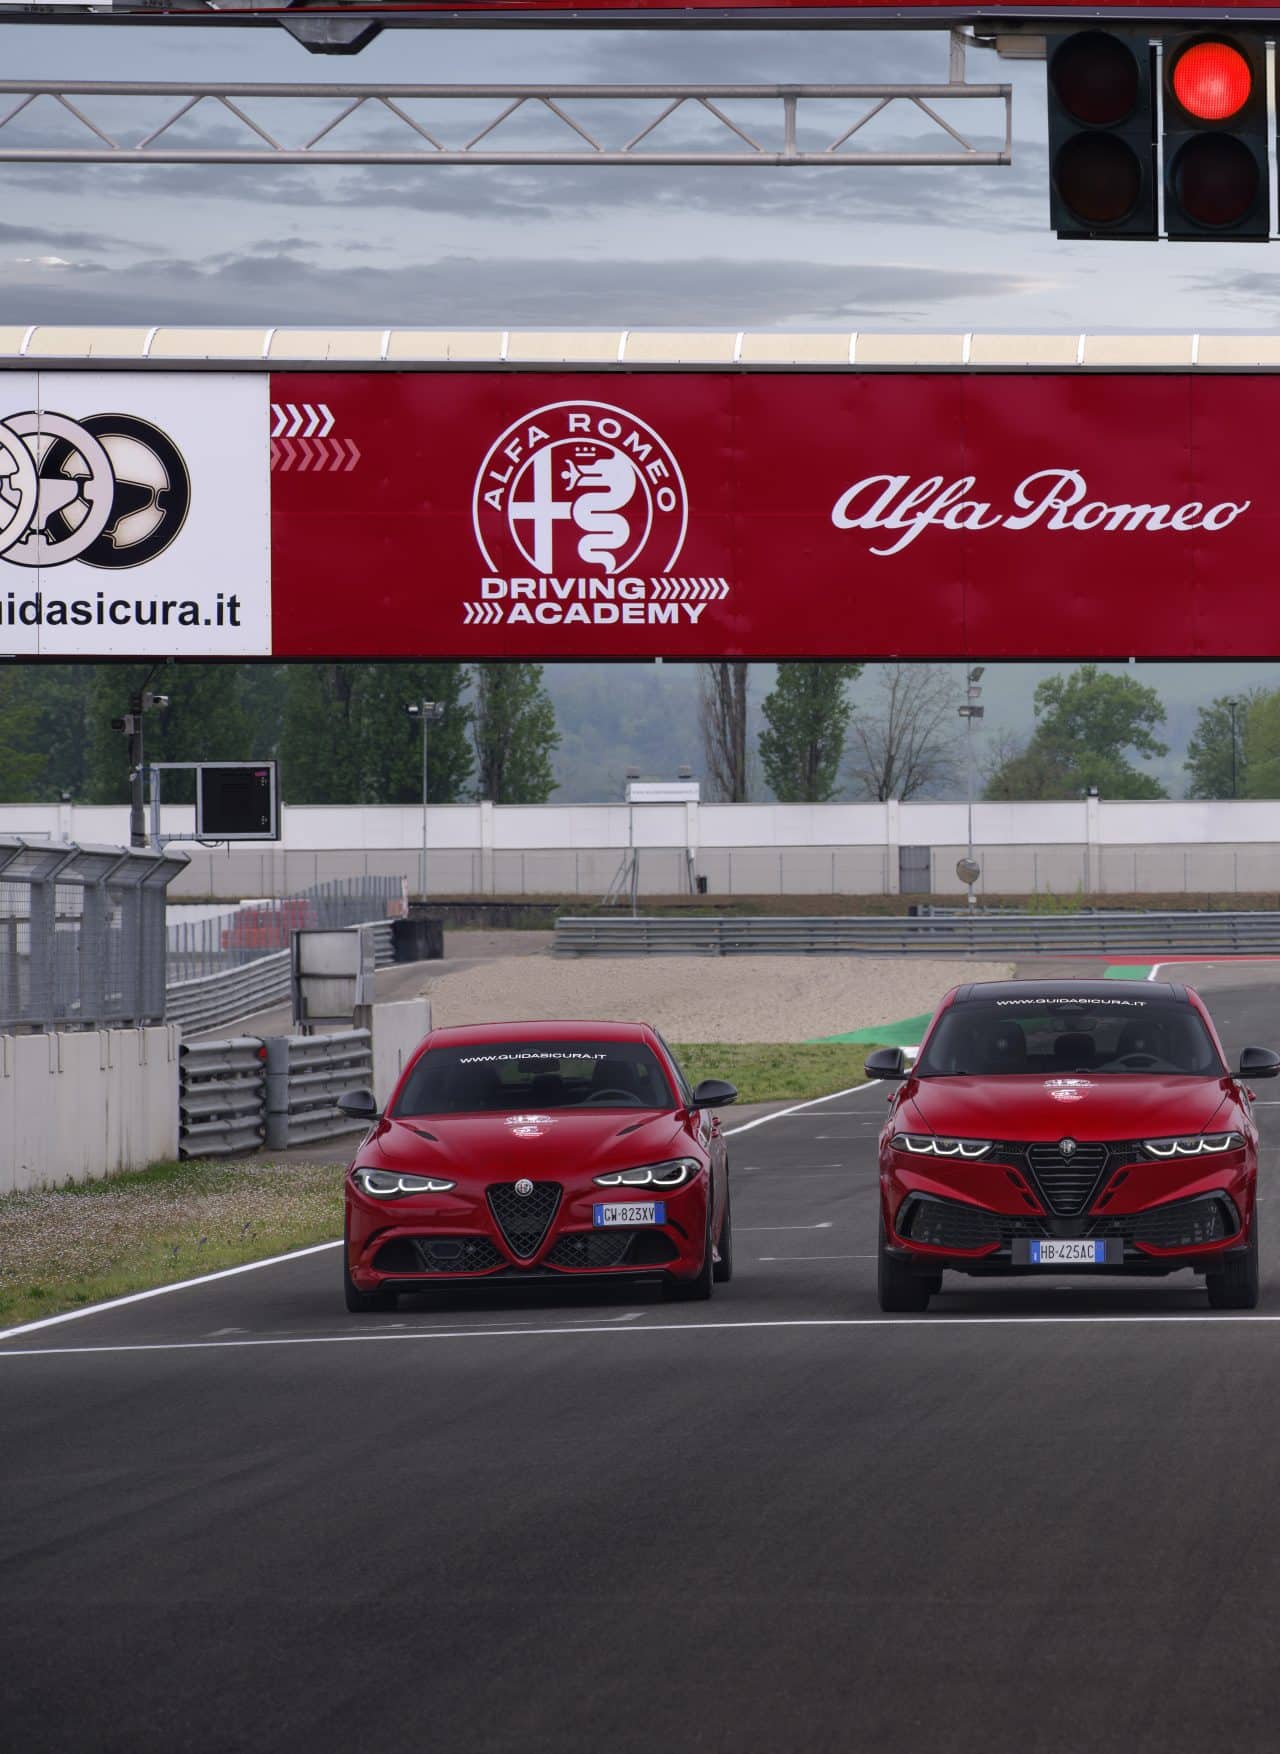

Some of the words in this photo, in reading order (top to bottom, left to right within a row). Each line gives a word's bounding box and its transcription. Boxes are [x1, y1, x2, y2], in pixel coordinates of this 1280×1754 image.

[484, 425, 550, 511] ALFA
[568, 413, 677, 512] ROMEO
[831, 474, 1002, 556] Alfa
[1001, 468, 1251, 531] Romeo
[481, 577, 647, 600] DRIVING
[0, 591, 241, 627] idasicura.it
[506, 602, 708, 624] ACADEMY
[459, 1052, 607, 1064] WWW.GUIDASICURA.IT
